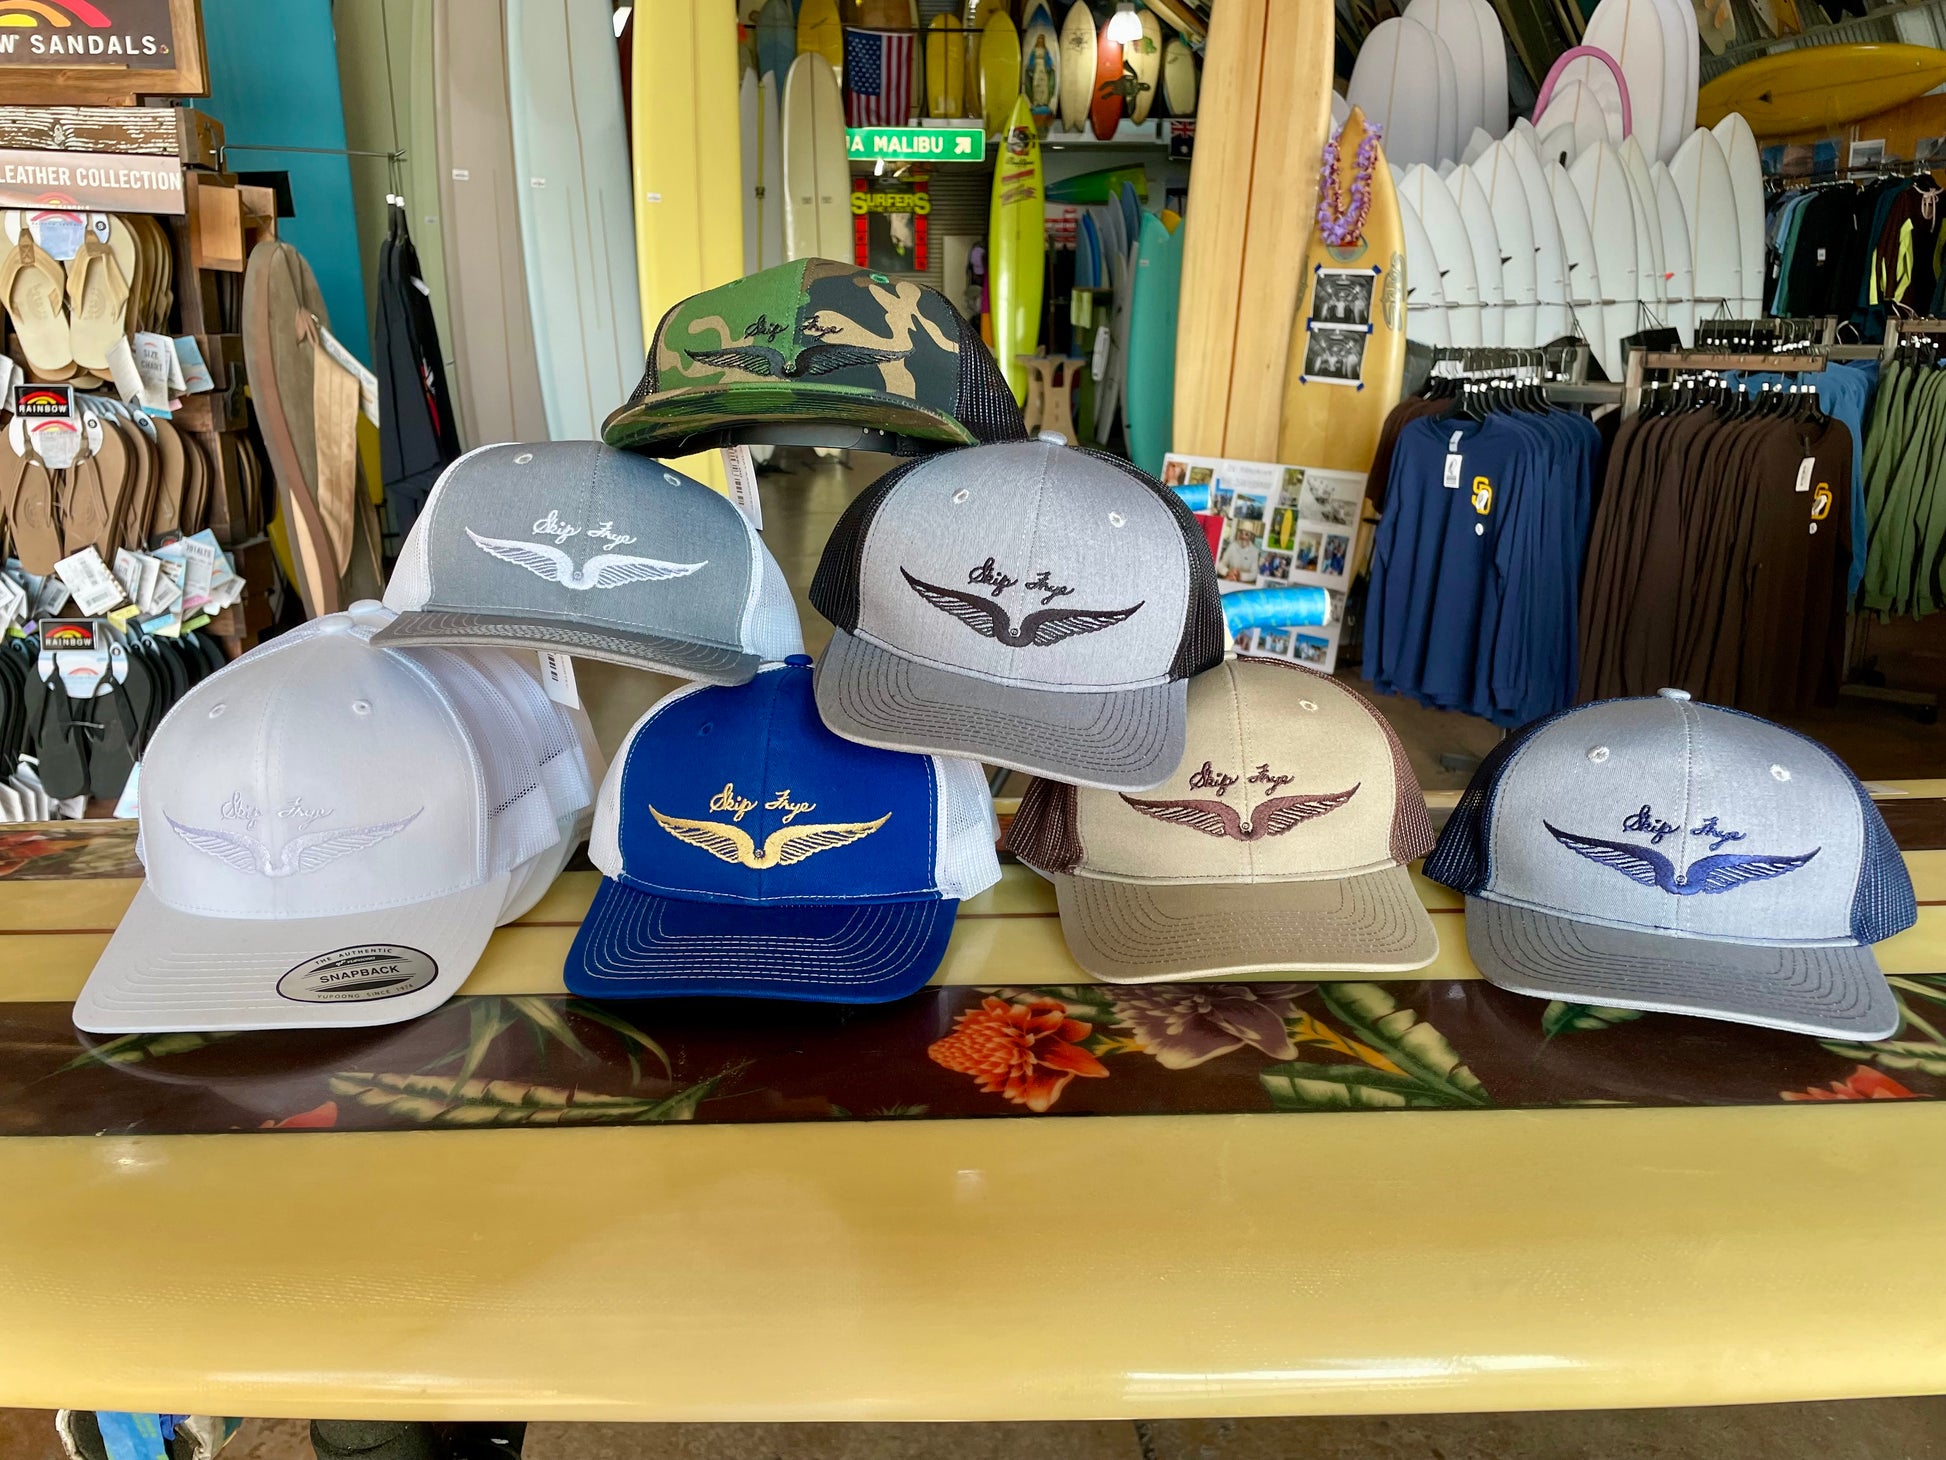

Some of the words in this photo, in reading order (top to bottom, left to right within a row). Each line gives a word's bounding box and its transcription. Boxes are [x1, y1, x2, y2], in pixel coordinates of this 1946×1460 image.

[30, 35, 157, 55] SANDALS
[873, 136, 943, 153] MALIBU
[76, 168, 182, 191] COLLECTION
[744, 314, 789, 342] Skip
[18, 404, 68, 413] RAINBOW
[532, 510, 582, 544] Skip
[587, 521, 637, 550] Frye
[968, 557, 1019, 597] Skip
[45, 638, 92, 646] RAINBOW
[1189, 760, 1239, 797] Skip
[221, 791, 264, 831] Skip
[709, 782, 758, 822] Skip
[764, 789, 817, 824] Frye
[1622, 804, 1681, 845] Skip
[315, 957, 332, 965] THE
[338, 948, 393, 958] AUTHENTIC
[319, 965, 400, 983] SNAPBACK
[366, 989, 391, 997] SINCE
